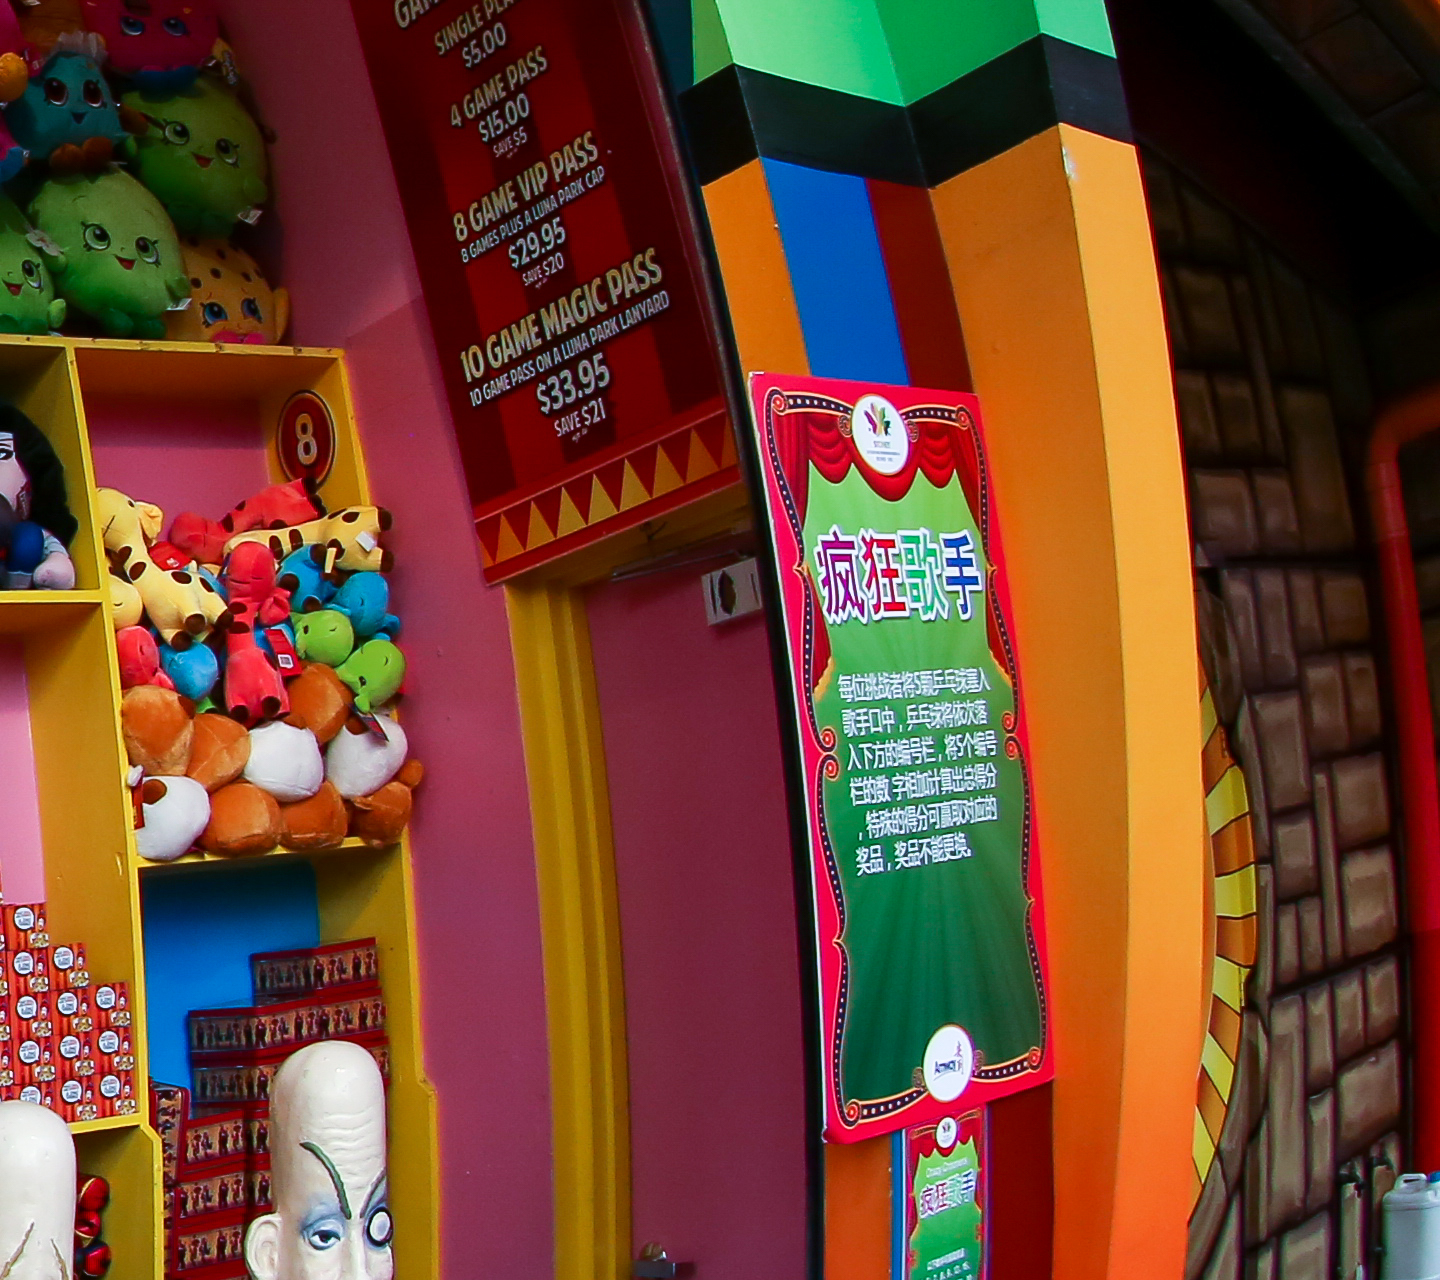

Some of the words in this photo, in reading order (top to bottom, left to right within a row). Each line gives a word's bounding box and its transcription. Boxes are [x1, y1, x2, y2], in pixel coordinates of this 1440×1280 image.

[434, 4, 484, 56] SINGLE
[462, 22, 507, 68] $5.00
[450, 103, 462, 128] 4
[463, 73, 508, 120] GAME
[506, 45, 548, 91] PASS
[479, 92, 530, 143] $15.00
[493, 135, 514, 159] SAVE
[512, 125, 528, 146] $5
[453, 211, 468, 242] 8
[468, 180, 519, 228] GAME
[517, 161, 549, 204] VIP
[549, 130, 599, 183] PASS
[461, 248, 469, 263] 8
[468, 228, 500, 259] GAMES
[499, 217, 524, 241] PLUS
[532, 194, 558, 220] LUNA
[558, 178, 585, 207] PARK
[585, 165, 605, 189] CAP
[508, 216, 566, 269] $29.95
[522, 265, 543, 287] SAVE
[542, 252, 565, 278] $20
[460, 344, 485, 384] 10
[486, 312, 543, 369] GAME
[540, 276, 608, 342] MAGIC
[606, 247, 663, 307] PASS
[469, 389, 482, 408] 10
[482, 374, 511, 401] GAME
[510, 360, 536, 388] PASS
[536, 354, 551, 374] ON
[562, 331, 589, 361] LUNA
[589, 317, 620, 347] PARK
[620, 290, 670, 332] LANYARD
[536, 352, 611, 415] $33.95
[296, 412, 318, 466] 8
[553, 415, 581, 438] SAVE
[580, 397, 607, 428] $21
[813, 525, 983, 624] 疯狂歌手
